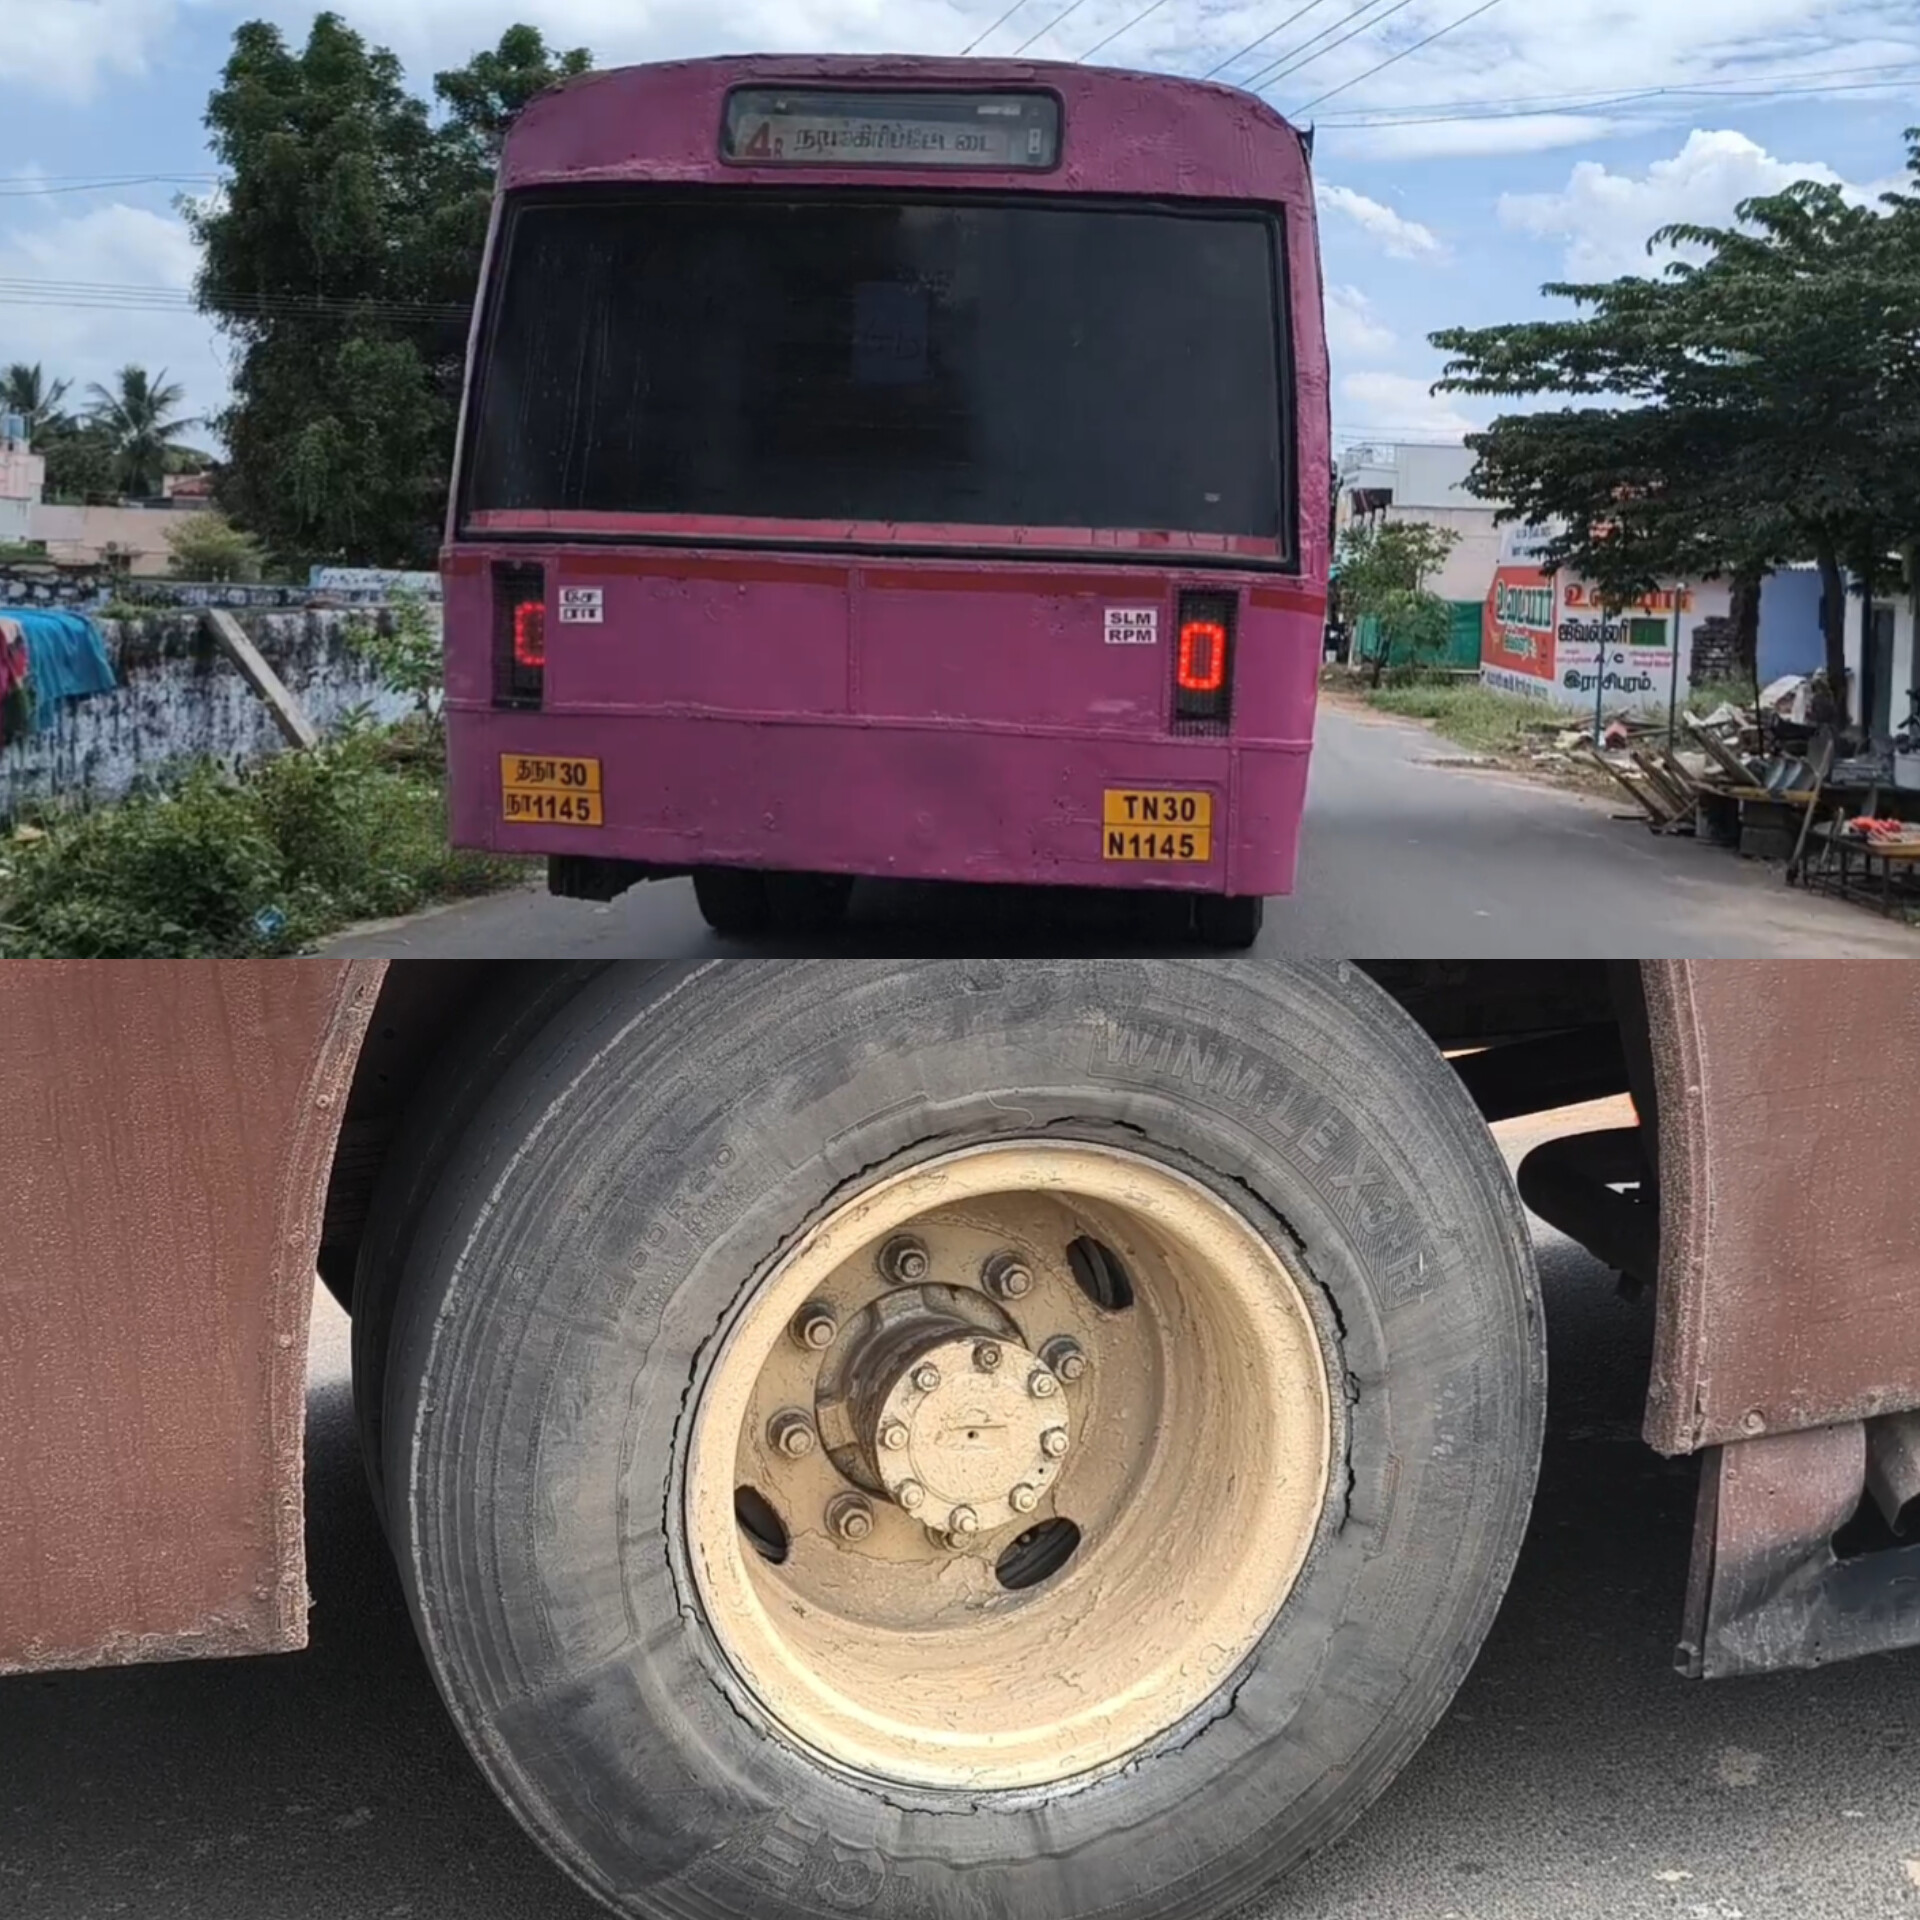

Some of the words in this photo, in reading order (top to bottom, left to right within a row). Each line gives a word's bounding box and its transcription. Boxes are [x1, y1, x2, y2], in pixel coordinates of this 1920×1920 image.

[1109, 611, 1151, 625] SLM
[1108, 628, 1151, 641] RPM
[1123, 796, 1196, 821] TN30
[1107, 832, 1195, 859] N1145
